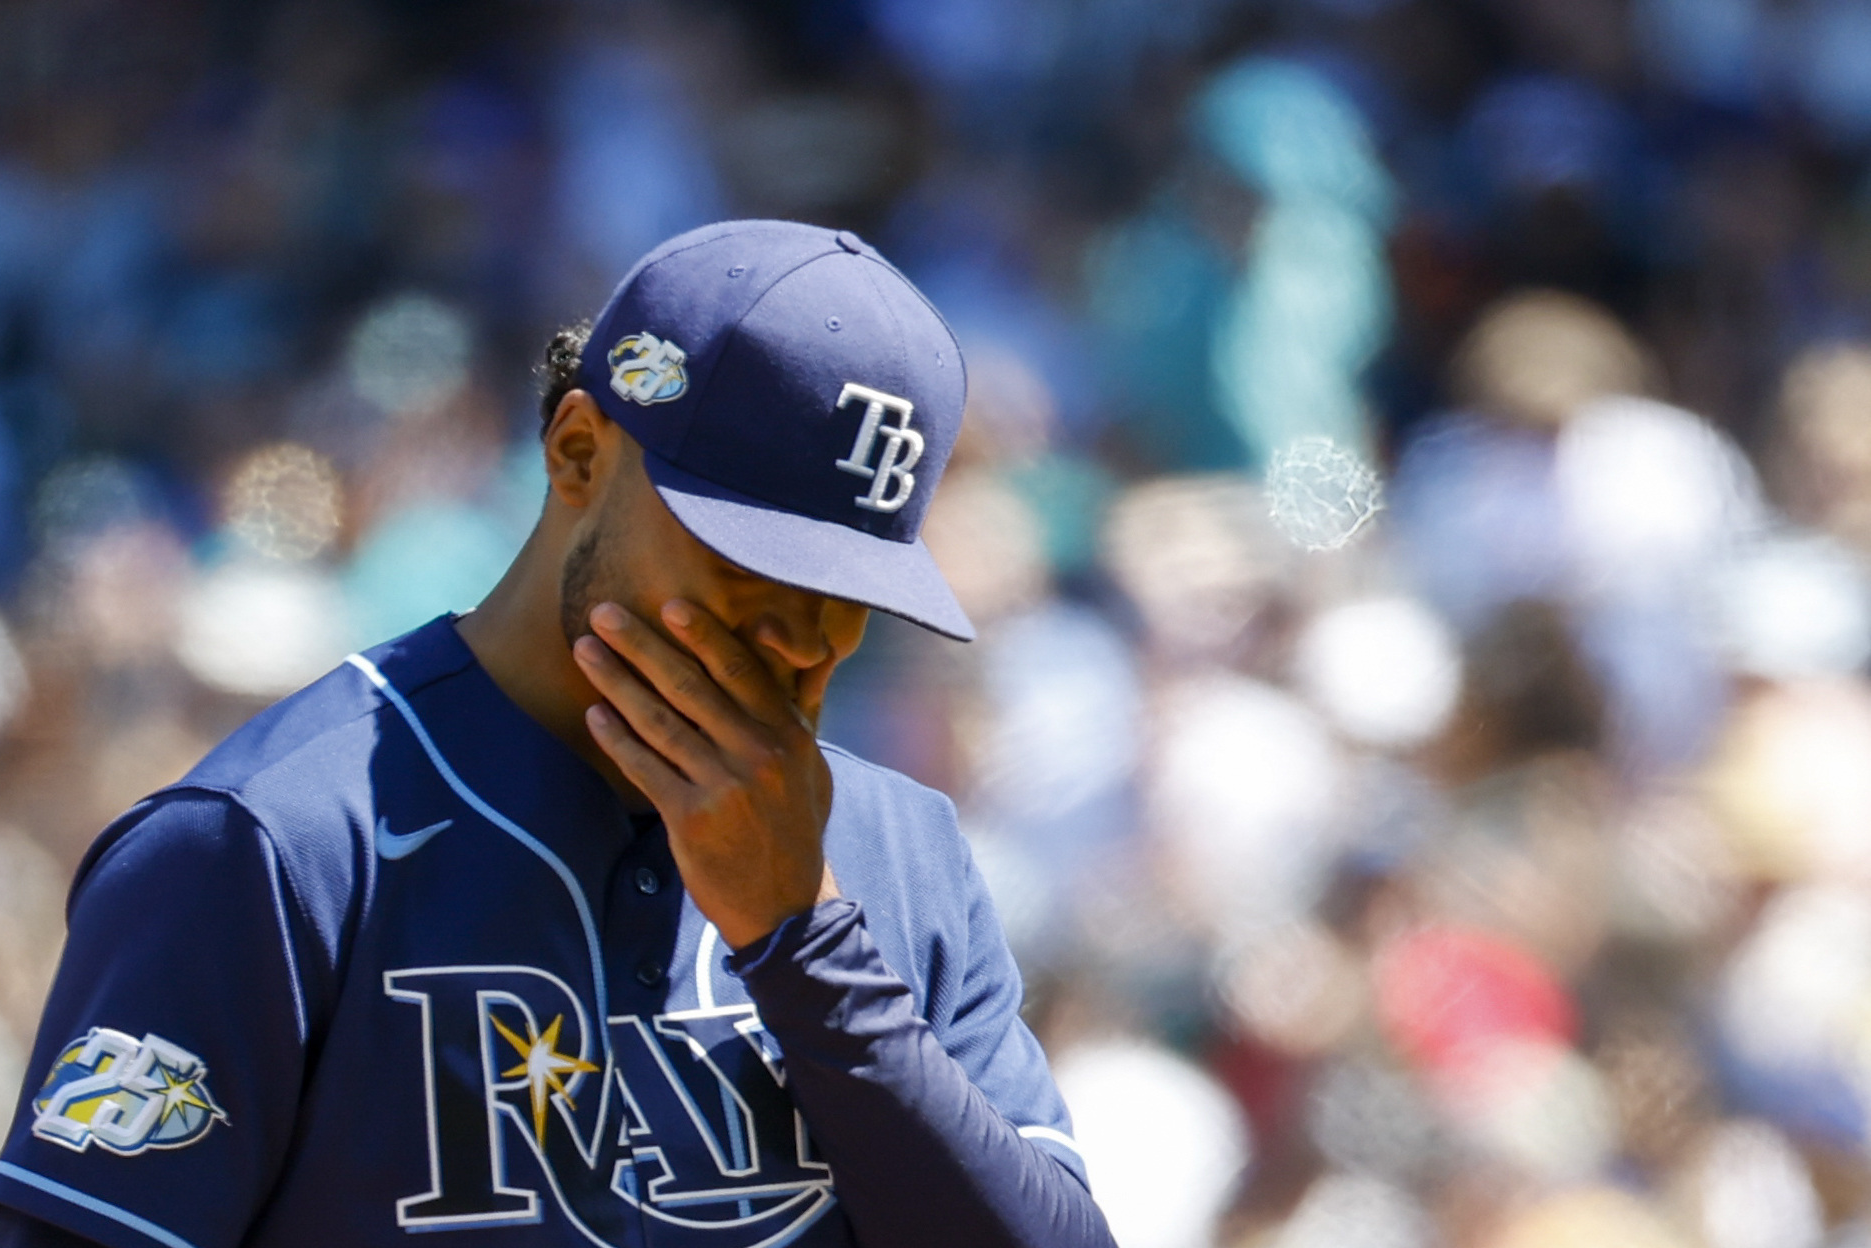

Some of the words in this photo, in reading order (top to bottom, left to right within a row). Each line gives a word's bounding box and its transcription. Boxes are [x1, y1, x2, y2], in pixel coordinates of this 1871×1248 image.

[609, 331, 687, 406] 25
[835, 382, 925, 514] TB
[31, 1026, 207, 1157] 25
